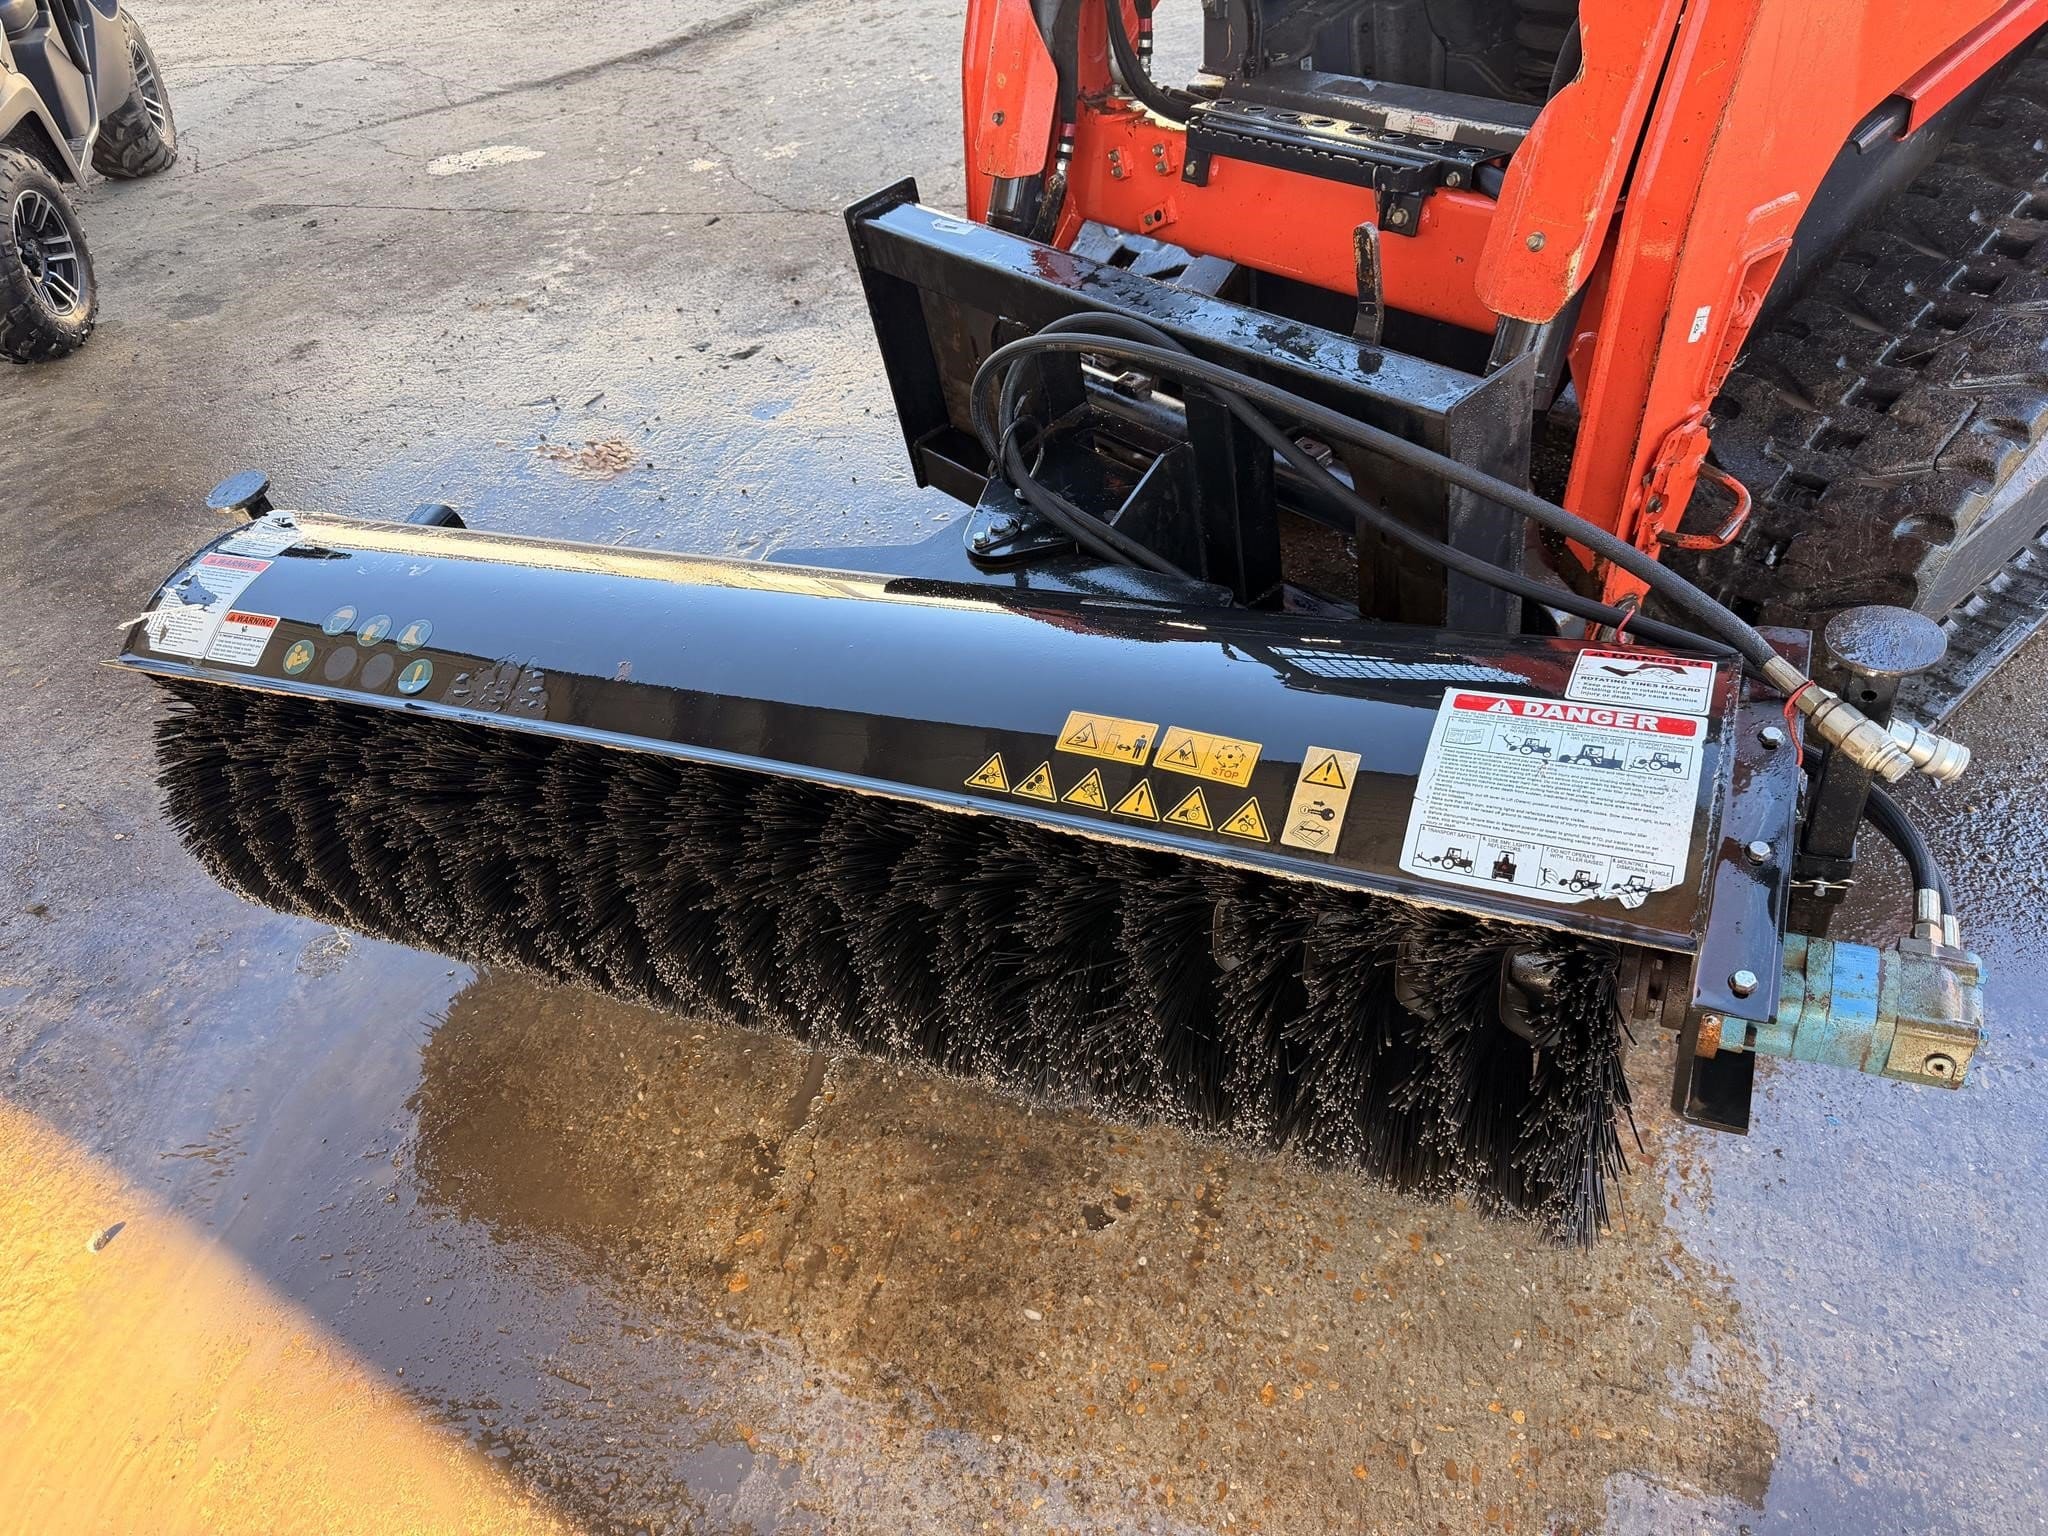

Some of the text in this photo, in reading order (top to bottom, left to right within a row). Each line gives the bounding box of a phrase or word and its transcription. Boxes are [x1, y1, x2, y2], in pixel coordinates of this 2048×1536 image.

[238, 615, 273, 627] WARNING
[1614, 653, 1702, 667] DANGER
[1580, 675, 1627, 684] ROTATING
[1521, 702, 1659, 731] DANGER
[1211, 767, 1239, 779] STOP
